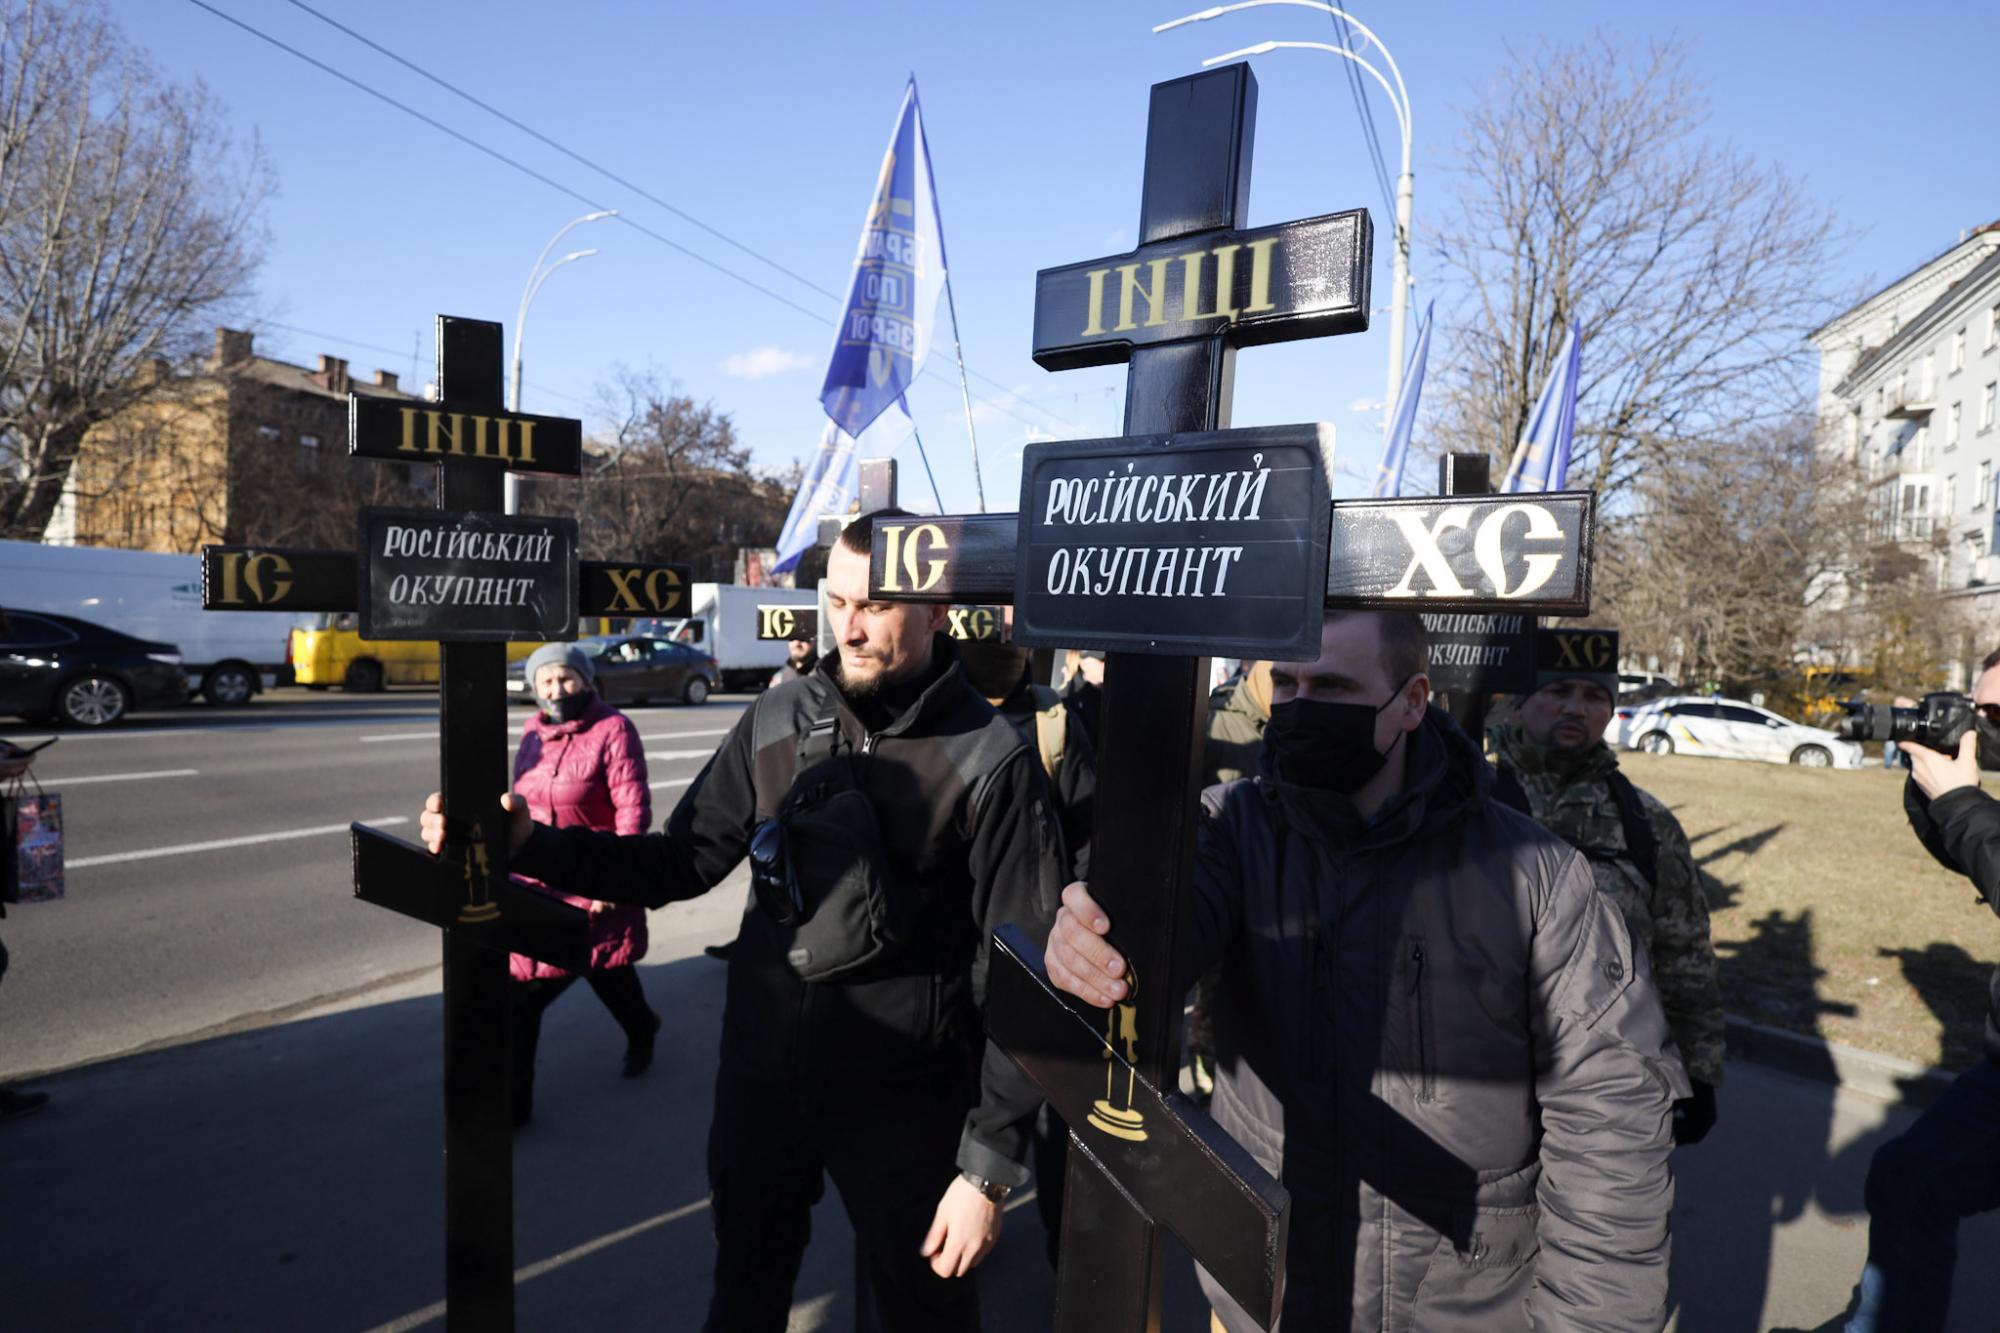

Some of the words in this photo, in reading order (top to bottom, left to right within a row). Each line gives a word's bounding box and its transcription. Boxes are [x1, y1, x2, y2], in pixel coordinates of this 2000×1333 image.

[1043, 452, 1272, 526] РОСІЙСЬКИЙ
[382, 522, 555, 563] РОСІЙСЬКИЙ
[388, 573, 536, 608] ОКУПАНТ
[1046, 546, 1244, 598] ОКУПАНТ
